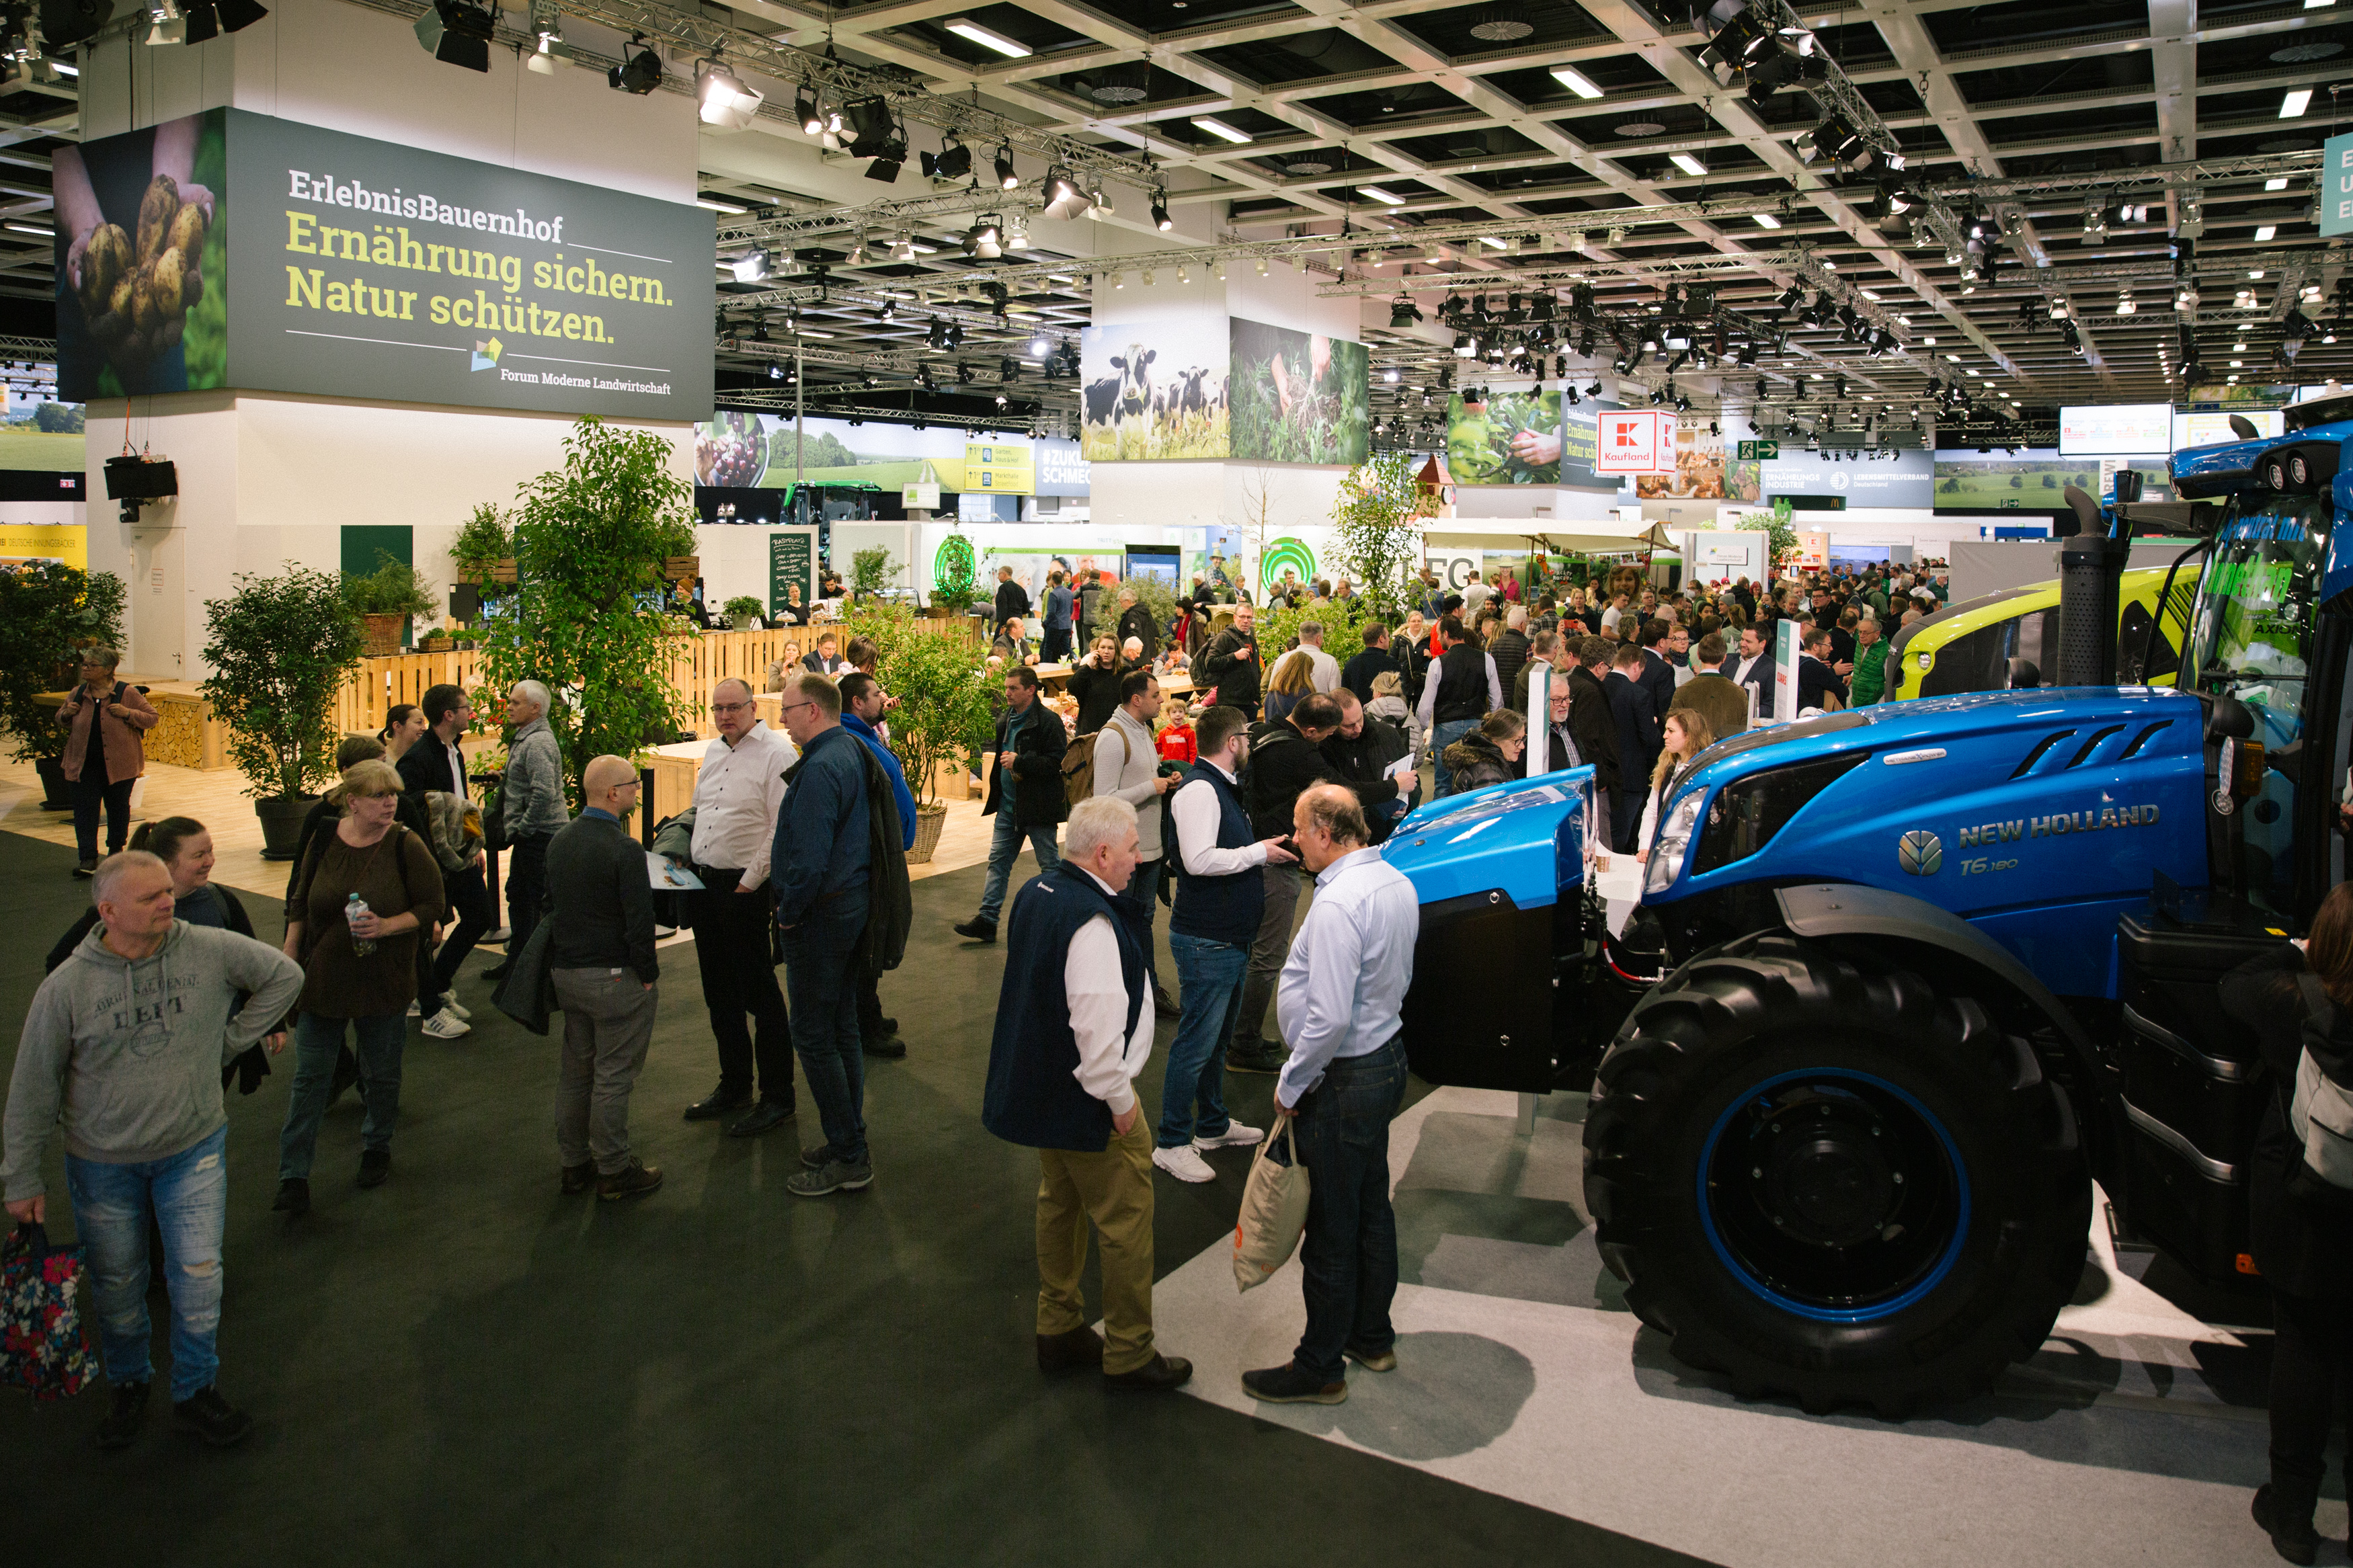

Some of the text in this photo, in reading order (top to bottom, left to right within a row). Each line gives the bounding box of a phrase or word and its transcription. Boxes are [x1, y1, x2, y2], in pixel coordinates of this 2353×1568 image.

[288, 169, 563, 244] ErlebnisBauernhof
[2338, 200, 2353, 218] E
[286, 210, 674, 307] Ernährung sichern.
[286, 266, 614, 344] Natur schützen.
[500, 368, 671, 395] Forum Moderne Landwirtschaft
[1043, 449, 1090, 466] #ZUKU
[1566, 441, 1584, 458] Natur
[1605, 452, 1649, 461] Kaufland
[1661, 453, 1674, 462] Kaufland
[1765, 472, 1820, 481] ERNÄHRUNGS
[1765, 481, 1805, 489] INDUSTRIE
[9, 538, 32, 547] DEUTSCHE
[34, 538, 76, 548] INNUNGSBÄCKER
[1553, 575, 1572, 583] Racker
[2254, 624, 2301, 634] AXION
[1776, 671, 1787, 686] CLAAS
[1959, 804, 2160, 849] NEW HOLLAND
[1960, 856, 2019, 876] T6.180
